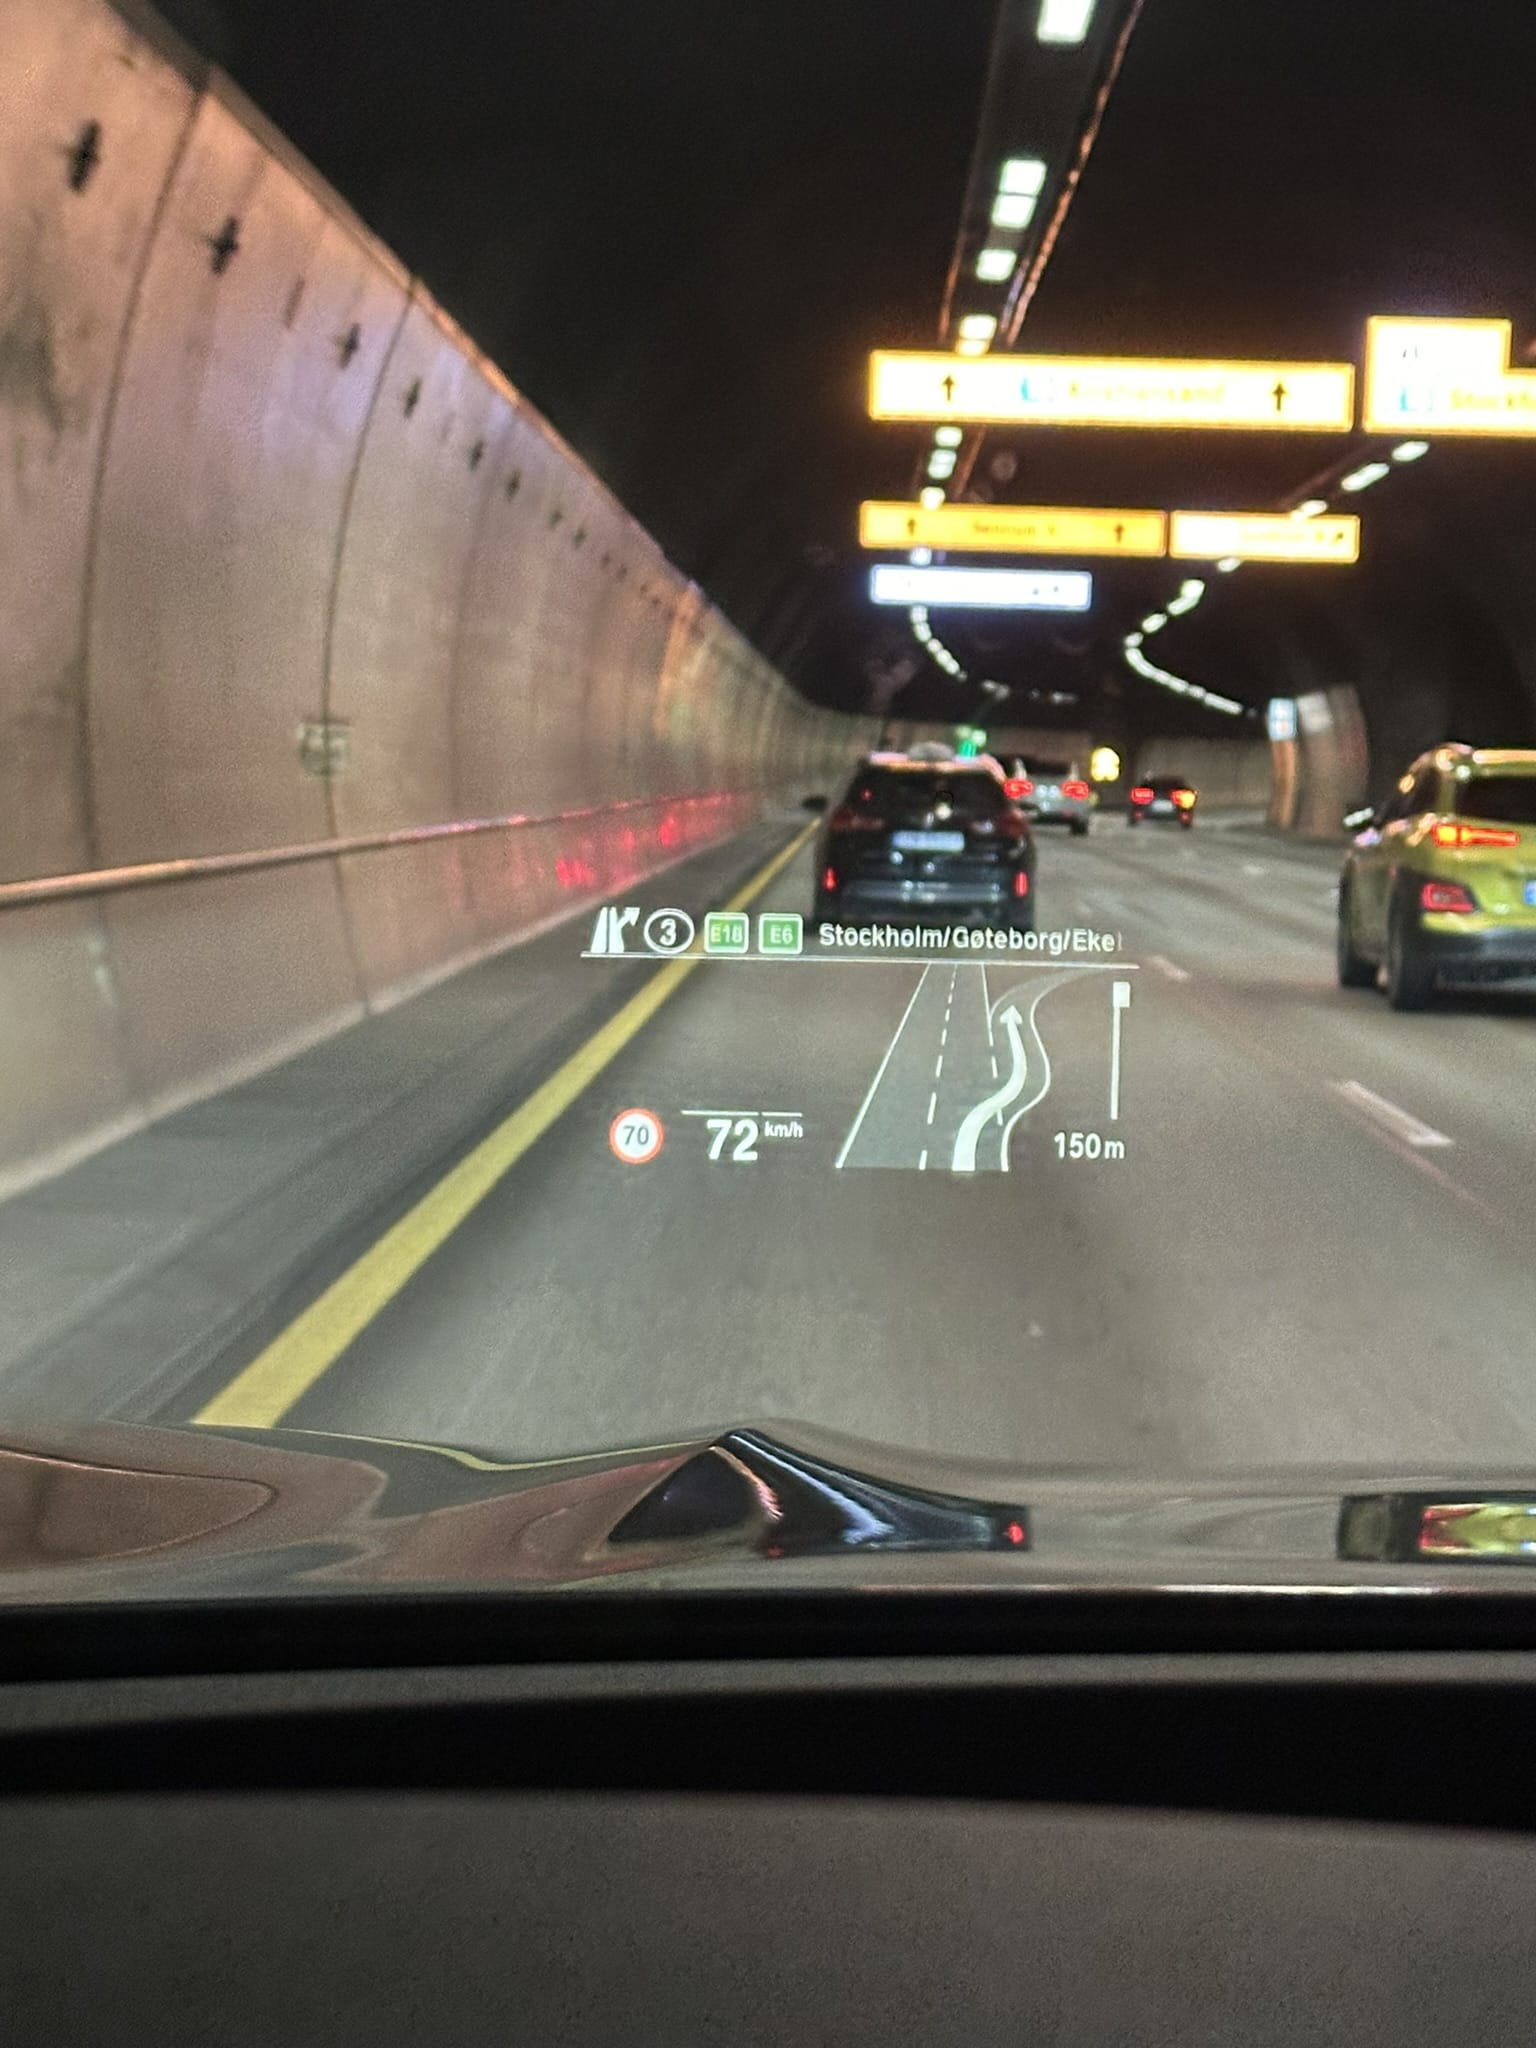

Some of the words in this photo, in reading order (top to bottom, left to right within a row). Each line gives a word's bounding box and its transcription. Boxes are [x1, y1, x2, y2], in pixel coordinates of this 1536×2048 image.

[660, 918, 677, 946] 3
[710, 924, 744, 944] E18
[769, 926, 794, 945] E6
[818, 922, 1123, 956] Stockholm/Gøteborg/Eke
[622, 1124, 650, 1147] 70
[706, 1118, 759, 1161] 72
[764, 1120, 804, 1138] km/h
